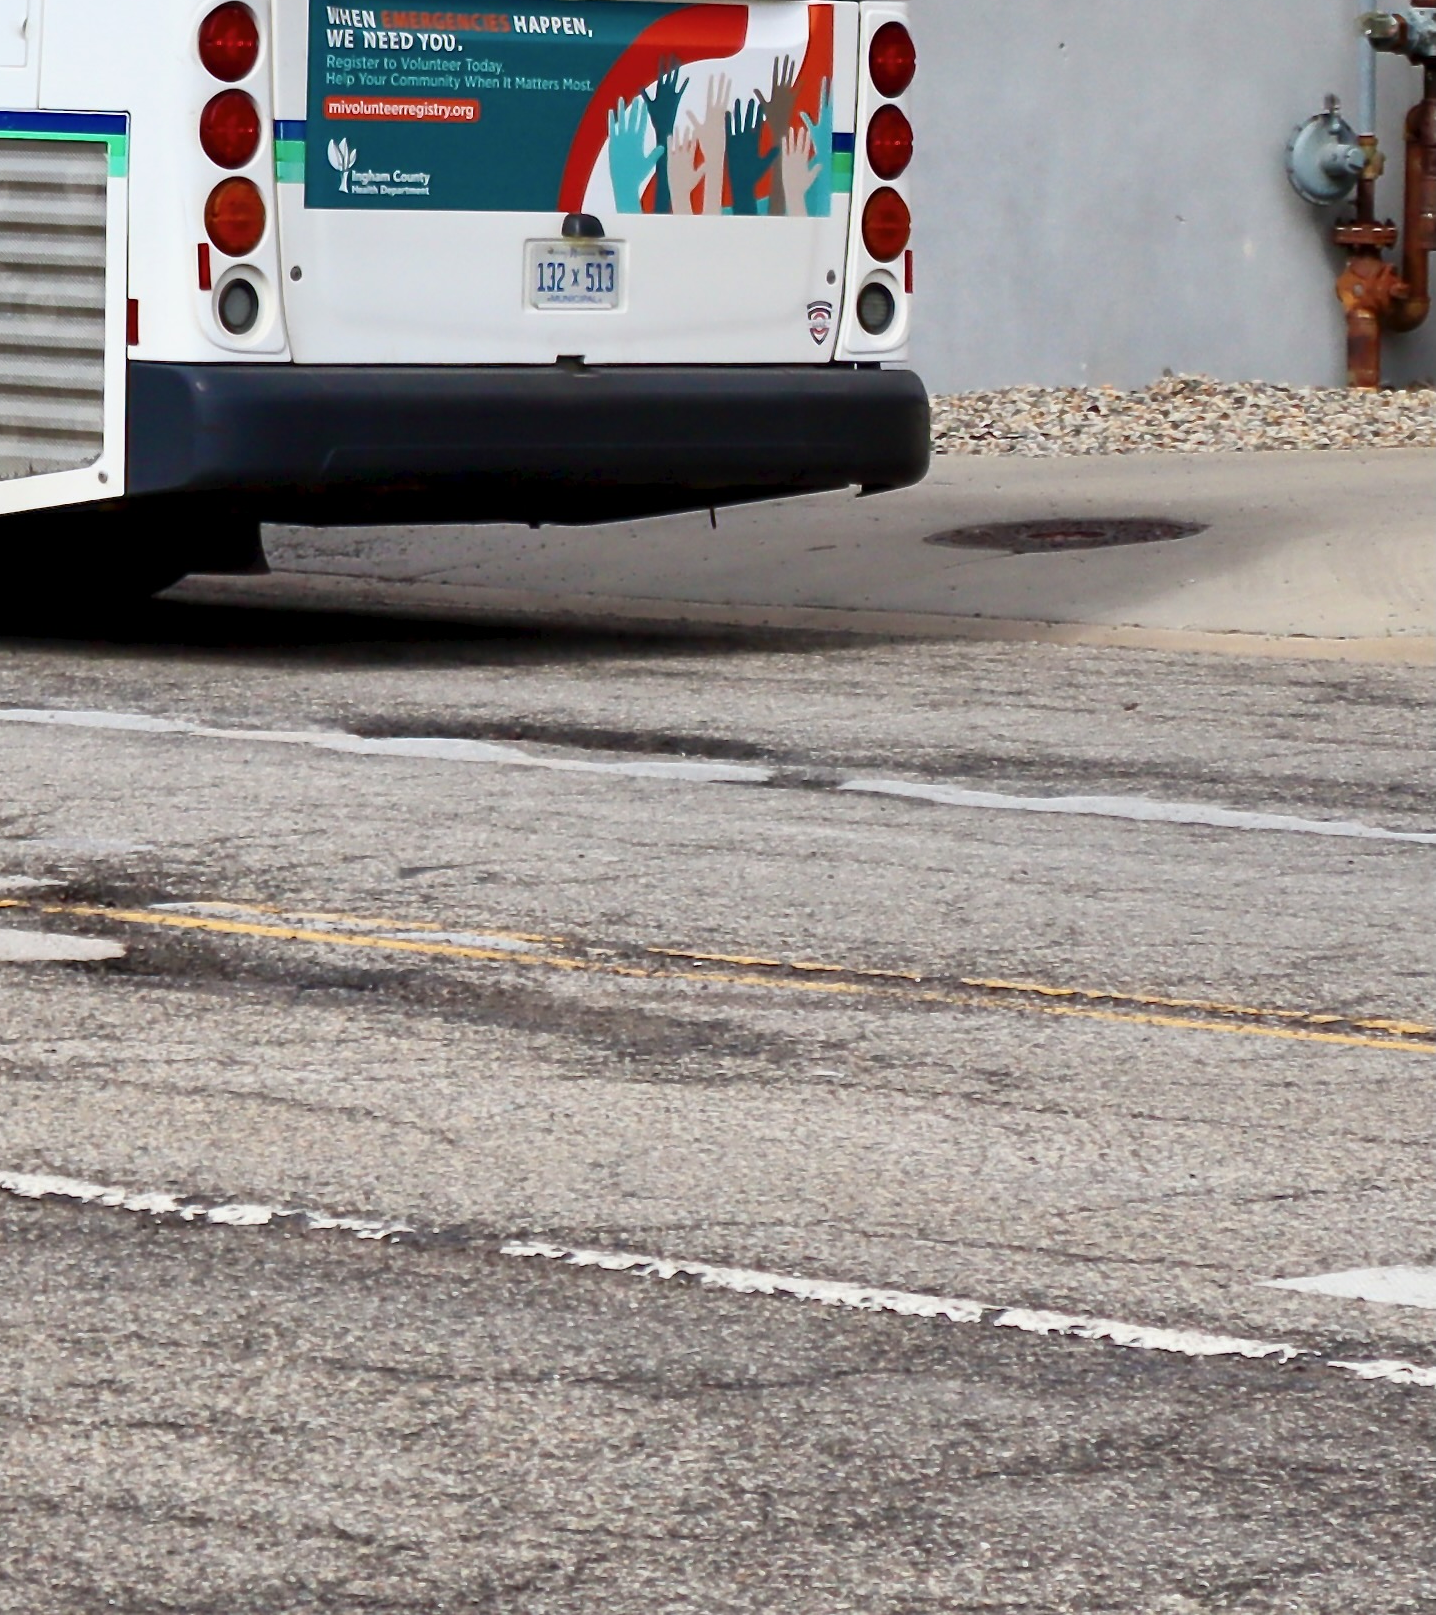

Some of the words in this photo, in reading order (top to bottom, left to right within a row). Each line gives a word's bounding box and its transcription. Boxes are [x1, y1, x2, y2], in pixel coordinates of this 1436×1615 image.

[326, 6, 376, 28] WHEN
[381, 10, 511, 33] EMERGENCIES
[513, 15, 594, 38] HAPPEN,
[326, 29, 354, 49] WE
[363, 31, 413, 50] NEED
[418, 34, 464, 52] YOU.
[326, 55, 380, 71] Register
[383, 57, 397, 70] to
[400, 57, 461, 72] Volunteer
[465, 58, 504, 74] Today.
[326, 72, 354, 86] Help
[359, 73, 386, 86] Your
[390, 73, 459, 90] Community
[465, 75, 500, 88] When
[515, 77, 559, 90] Matters
[562, 78, 595, 91] Most.
[328, 100, 474, 119] mivolunteerregistry.org
[351, 170, 391, 185] Ingham
[392, 170, 430, 185] County
[537, 263, 566, 292] 132
[585, 263, 614, 292] 513
